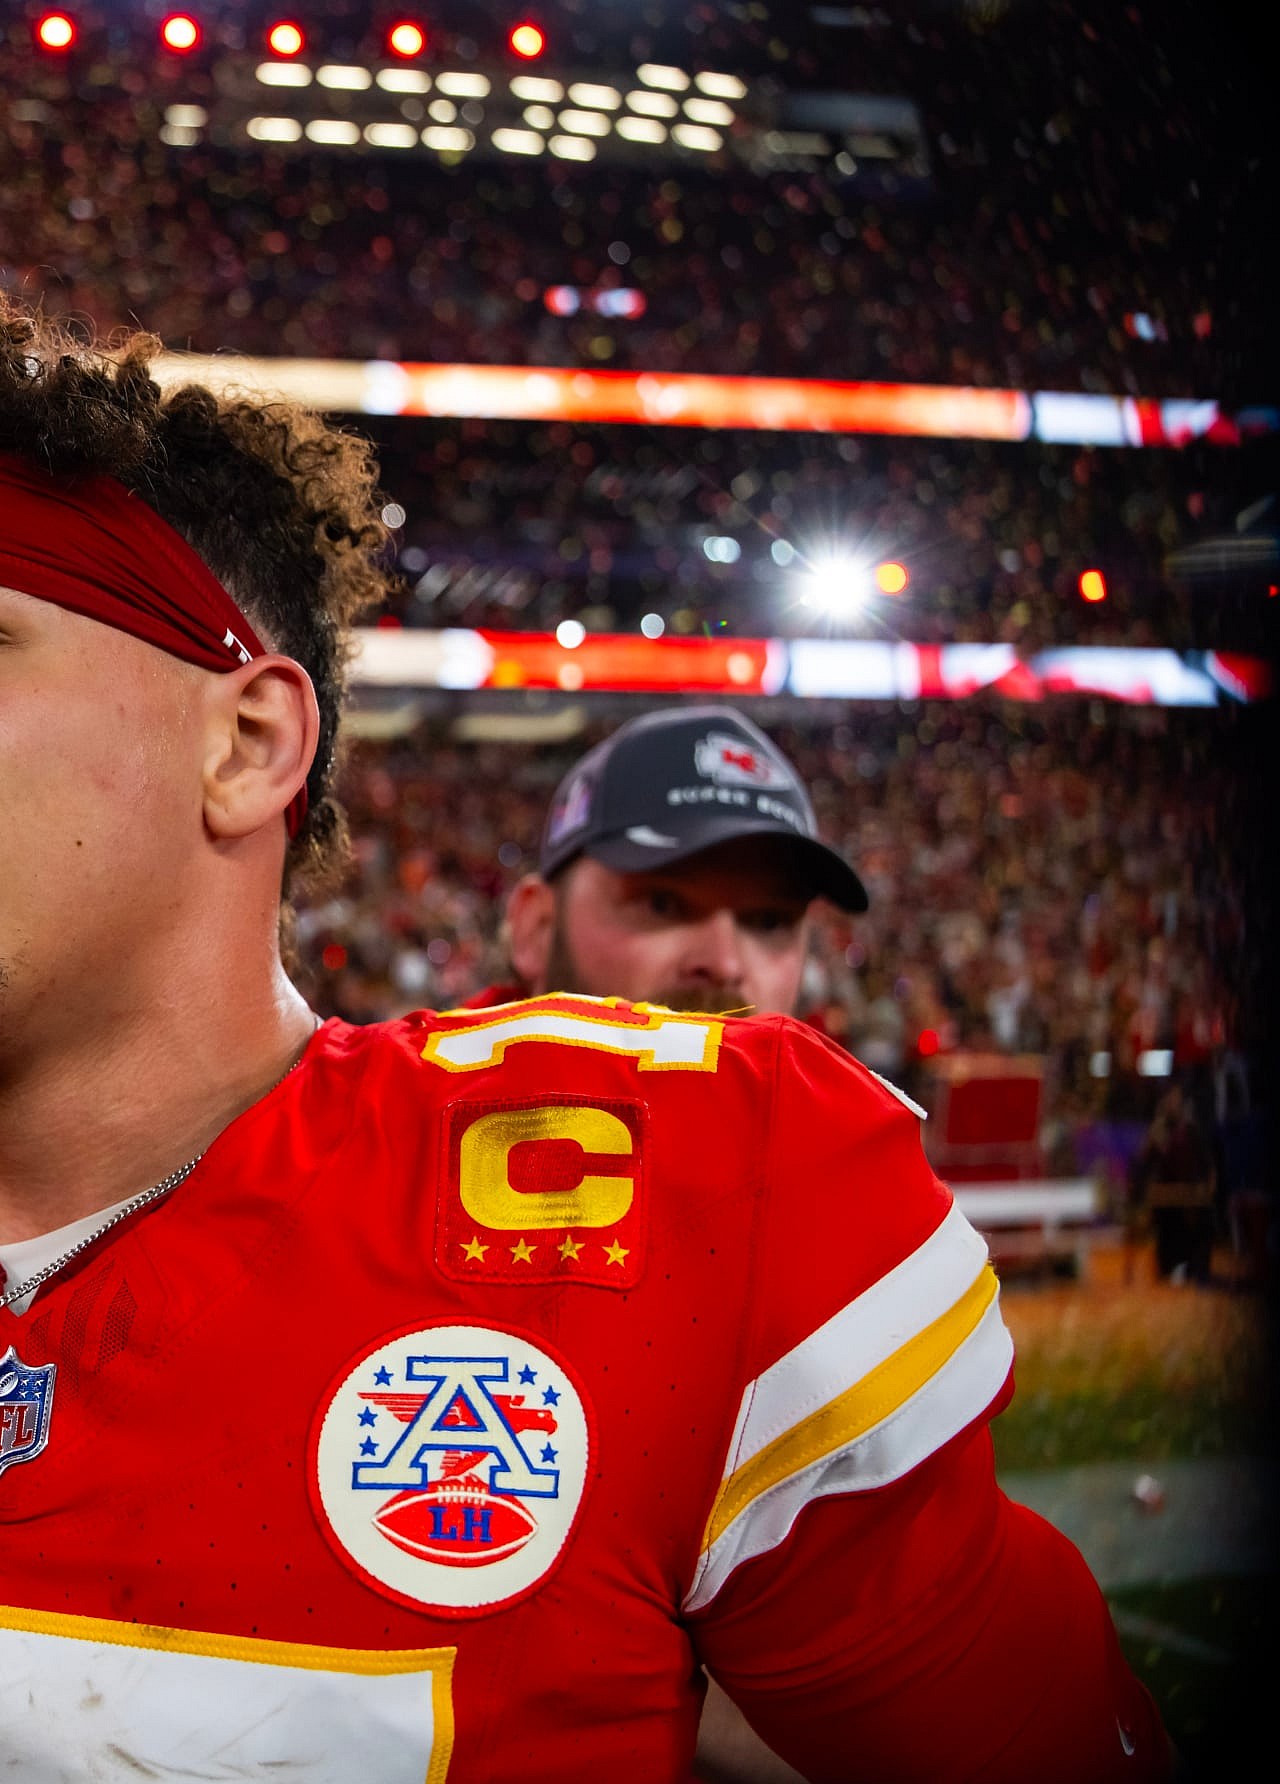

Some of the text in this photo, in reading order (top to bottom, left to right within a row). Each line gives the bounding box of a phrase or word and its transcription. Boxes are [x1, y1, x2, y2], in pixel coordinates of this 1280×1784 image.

[460, 1105, 634, 1231] C
[352, 1356, 560, 1498] A
[428, 1506, 493, 1543] LH
